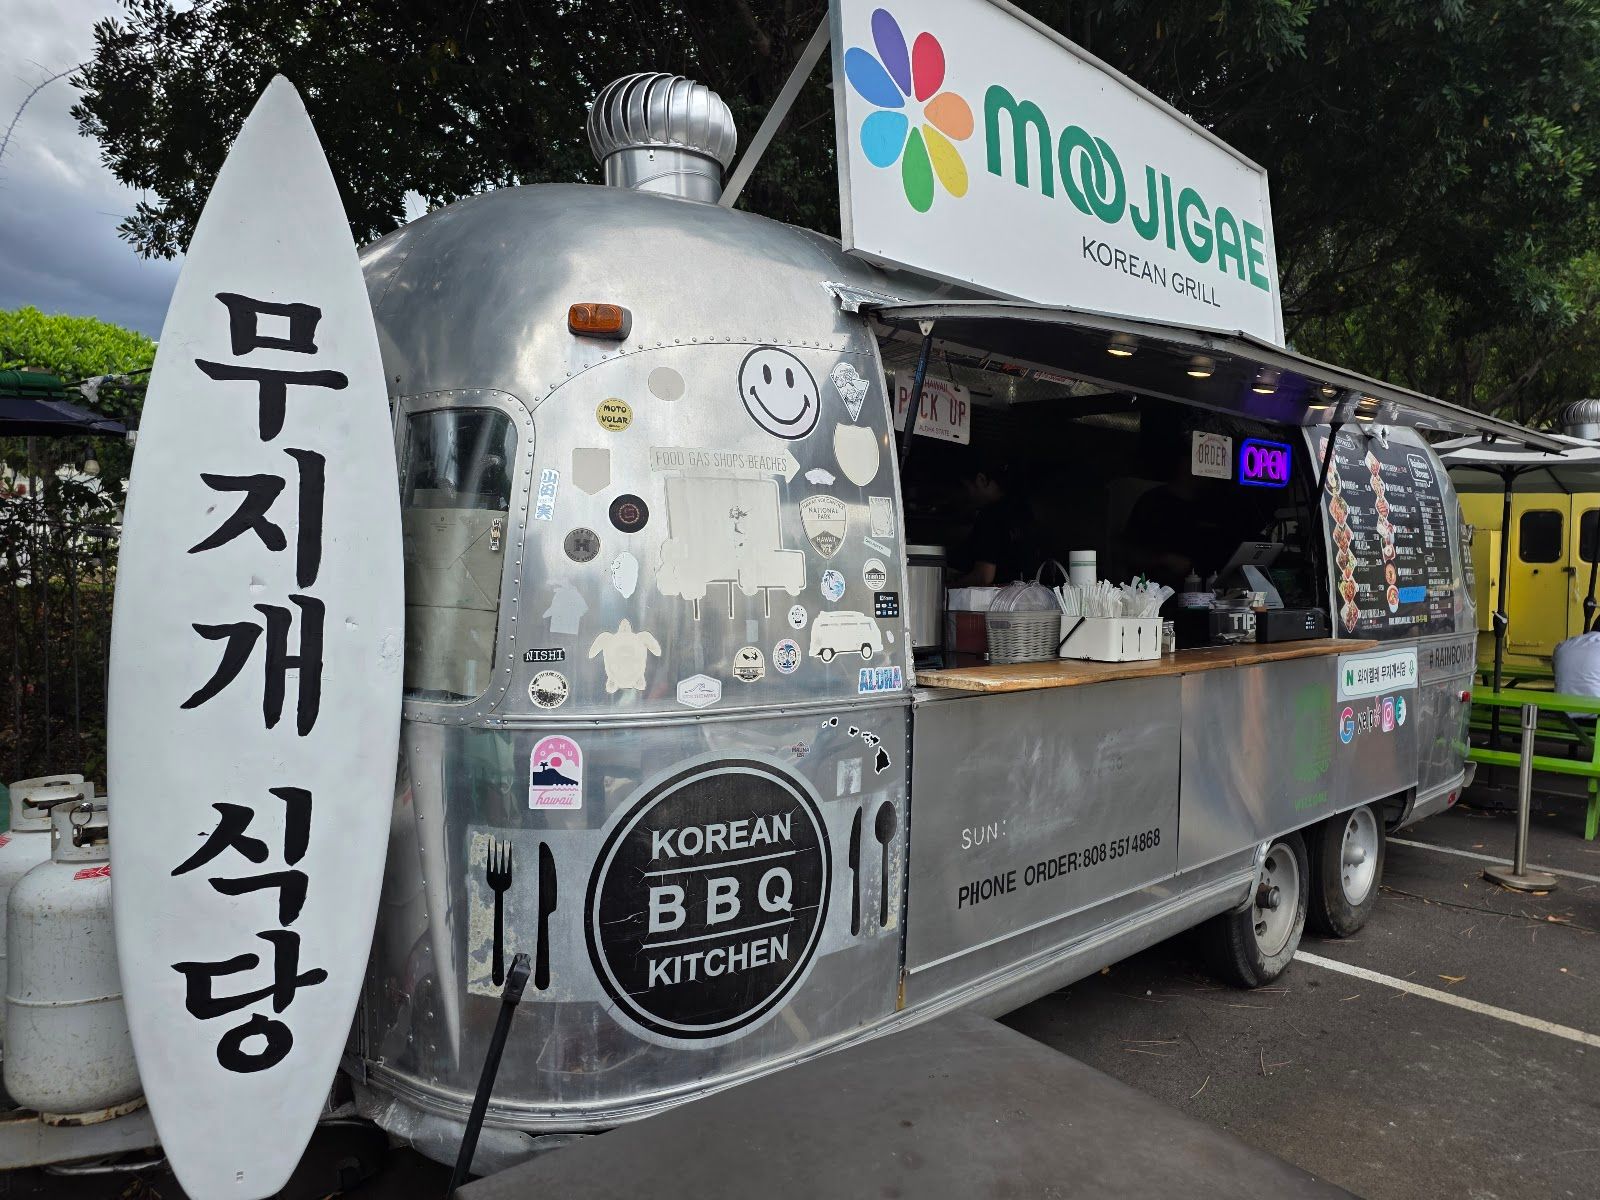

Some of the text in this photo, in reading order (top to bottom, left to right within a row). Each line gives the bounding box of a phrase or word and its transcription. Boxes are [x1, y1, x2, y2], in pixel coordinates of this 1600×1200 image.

[984, 84, 1270, 292] MOOJIGAE
[1082, 236, 1221, 308] KOREAN GRILL
[601, 414, 629, 424] VOLAR
[603, 404, 627, 413] MOTO
[899, 386, 967, 428] PCK UP
[655, 451, 788, 472] FOOD GAS SHOPS BEACHES
[1198, 444, 1227, 467] ORDER
[1244, 446, 1288, 480] OPEN
[1228, 613, 1257, 631] TIP
[525, 649, 564, 661] NISHI
[1435, 643, 1467, 667] RAINBOW
[171, 292, 349, 1073] 무지개 식당
[859, 667, 902, 692] ALOHA
[1346, 669, 1354, 686] N
[1381, 661, 1407, 681] 무지개식당
[1357, 706, 1374, 735] yelp
[540, 743, 574, 758] OAHU
[651, 813, 793, 860] KOREAN
[957, 870, 1017, 909] PHONE
[1109, 827, 1162, 861] 5514868
[648, 933, 790, 988] KITCHEN
